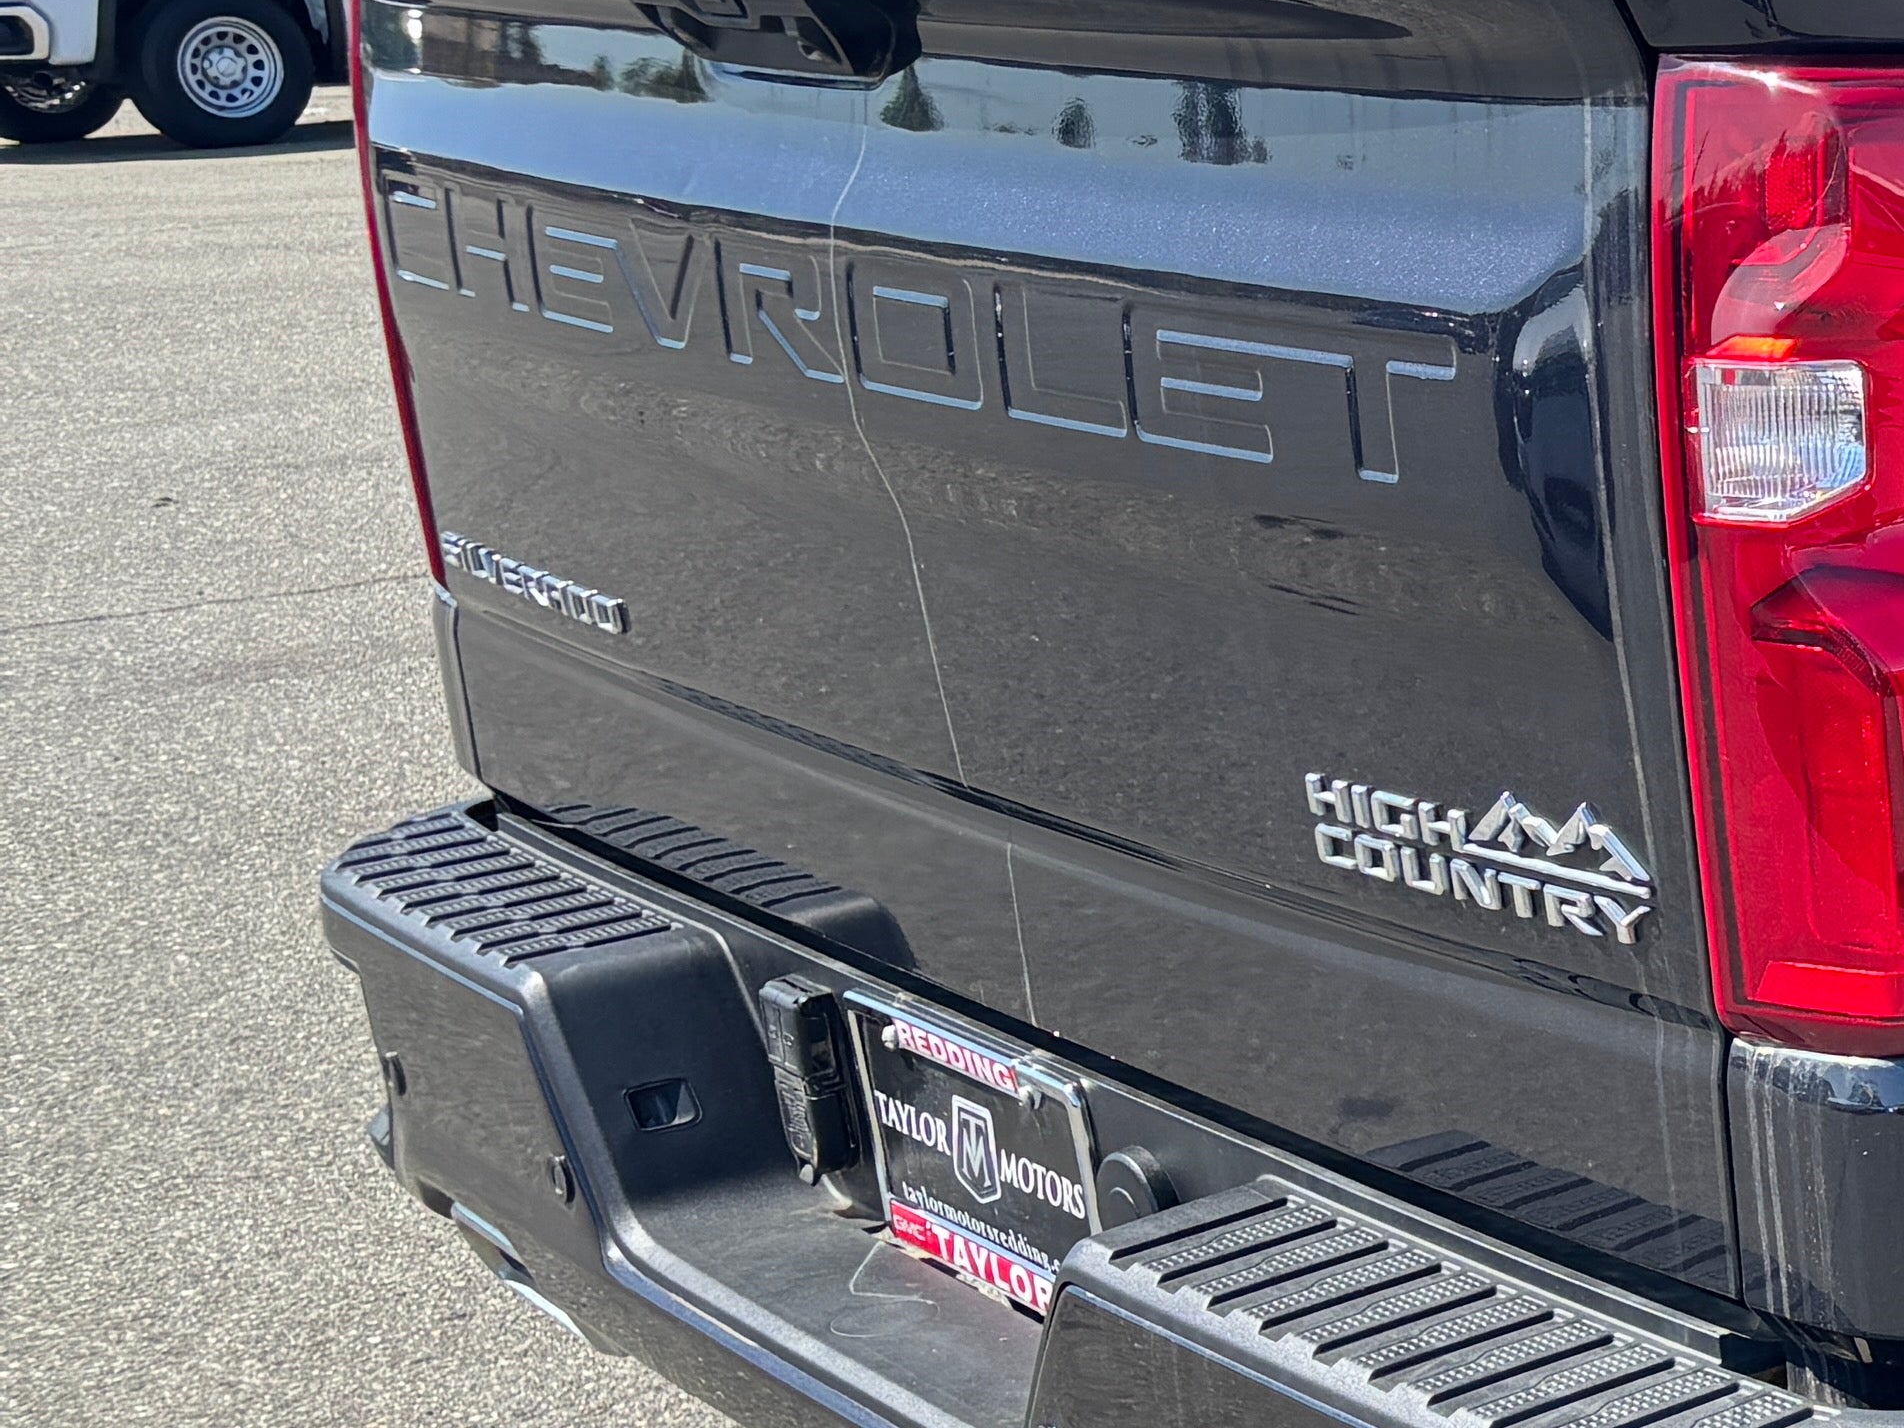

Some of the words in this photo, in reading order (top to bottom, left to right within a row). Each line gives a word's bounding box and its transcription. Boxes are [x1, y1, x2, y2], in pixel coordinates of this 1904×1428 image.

[380, 169, 1456, 484] CHEVROLET
[440, 531, 632, 635] SILVERADO
[1304, 772, 1468, 853] HIGH
[1314, 821, 1652, 945] COUNTRY
[896, 1022, 1019, 1092] REDDING
[873, 1088, 952, 1157] TAYLOR
[1000, 1148, 1086, 1220] MOTORS
